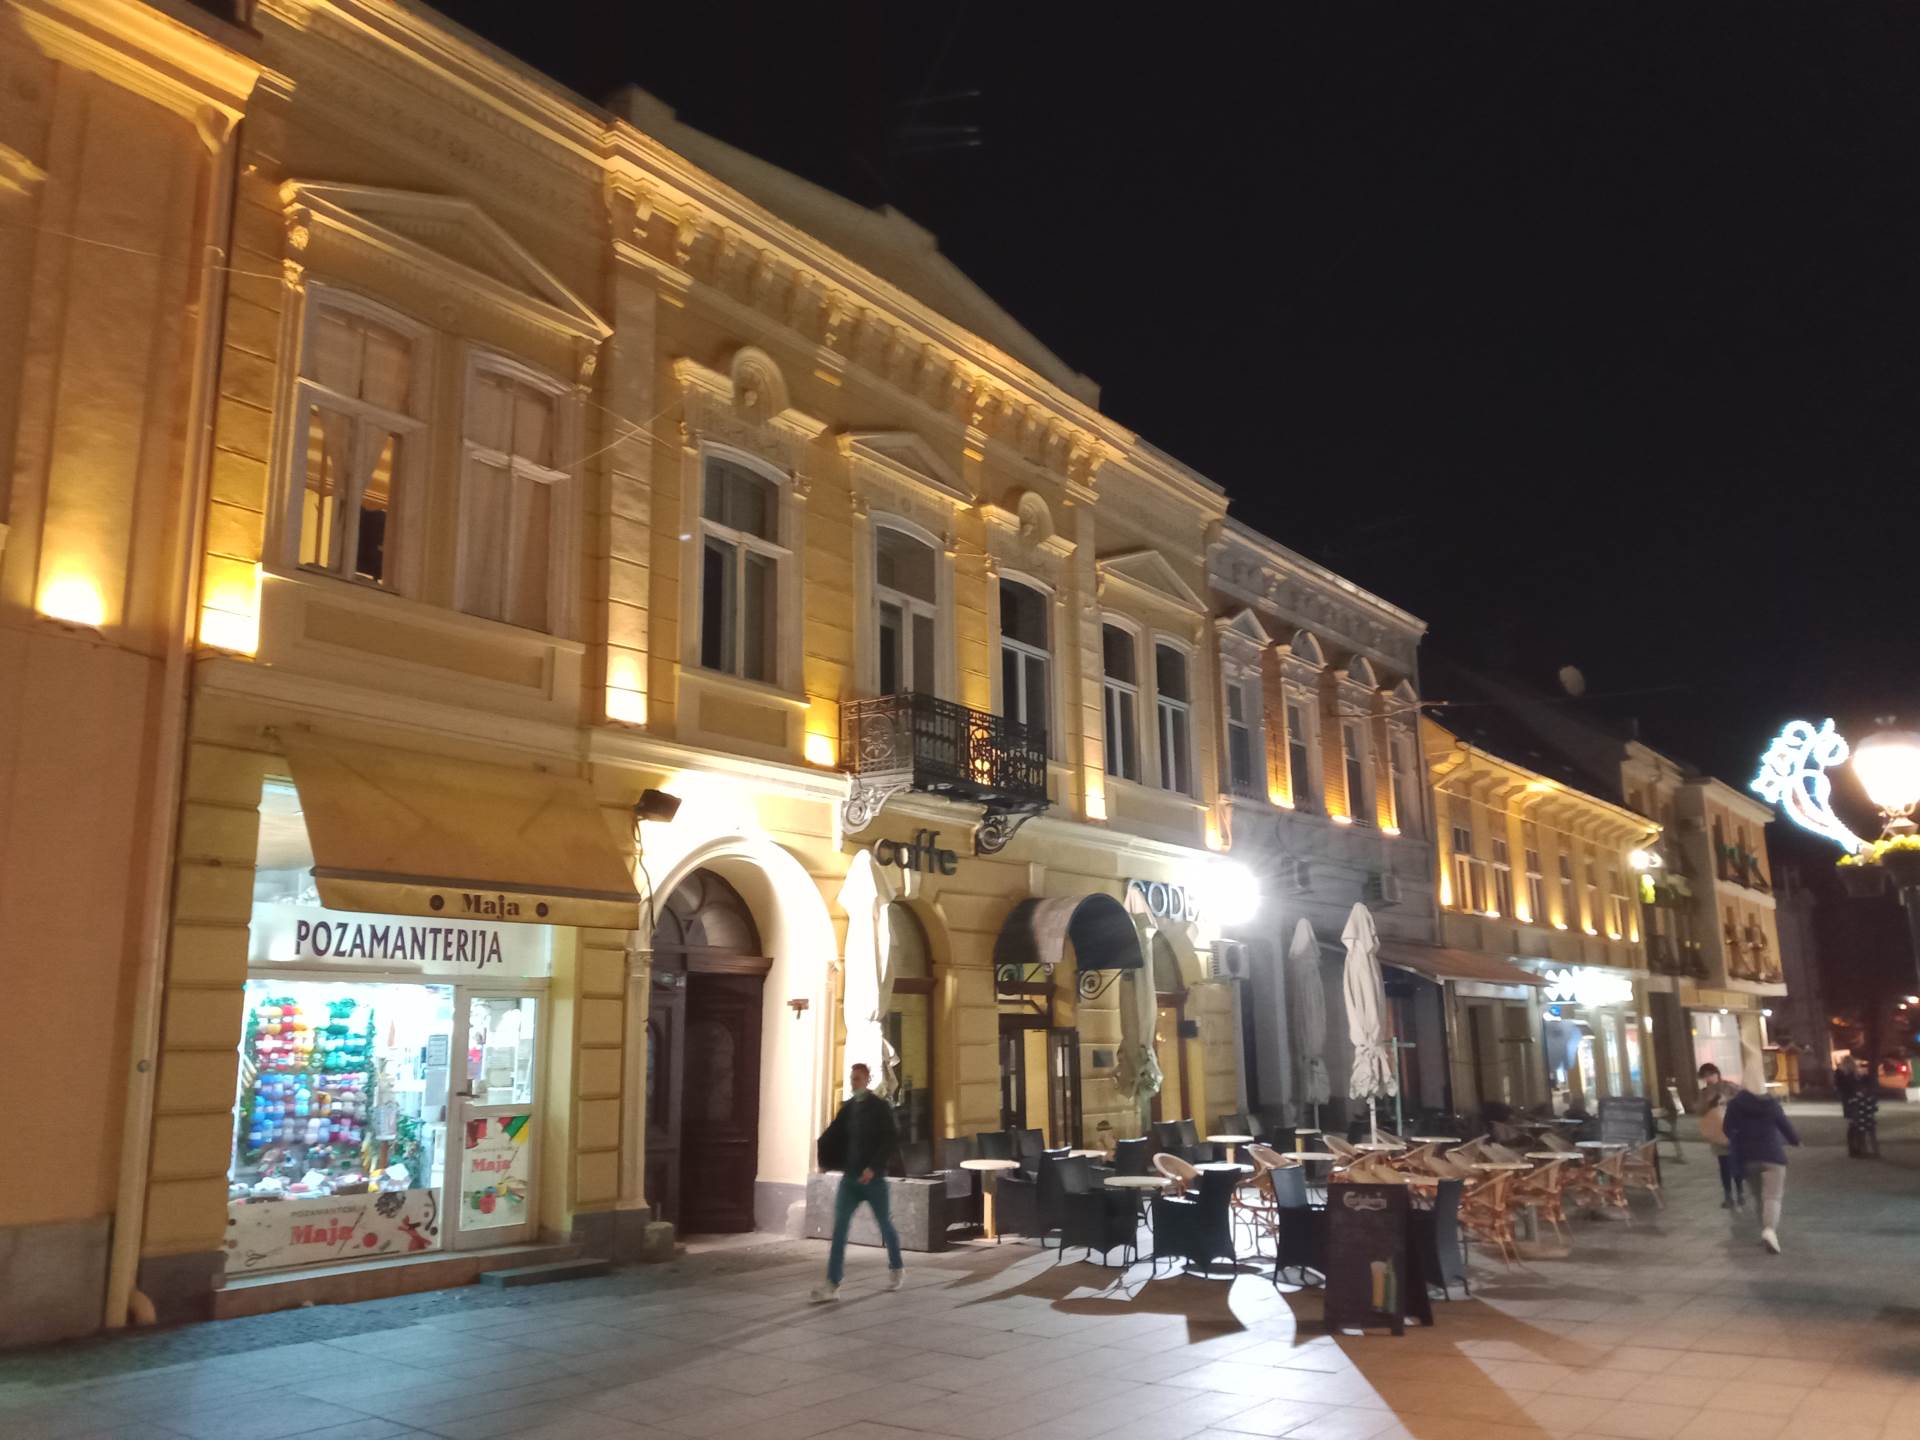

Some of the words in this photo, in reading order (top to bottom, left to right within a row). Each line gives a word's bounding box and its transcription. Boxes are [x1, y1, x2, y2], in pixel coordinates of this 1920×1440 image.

[873, 828, 958, 875] caffe
[461, 893, 521, 919] Maja
[294, 919, 503, 969] POZAMANTERIJA
[472, 1153, 512, 1173] Maja
[289, 1217, 353, 1246] Maja
